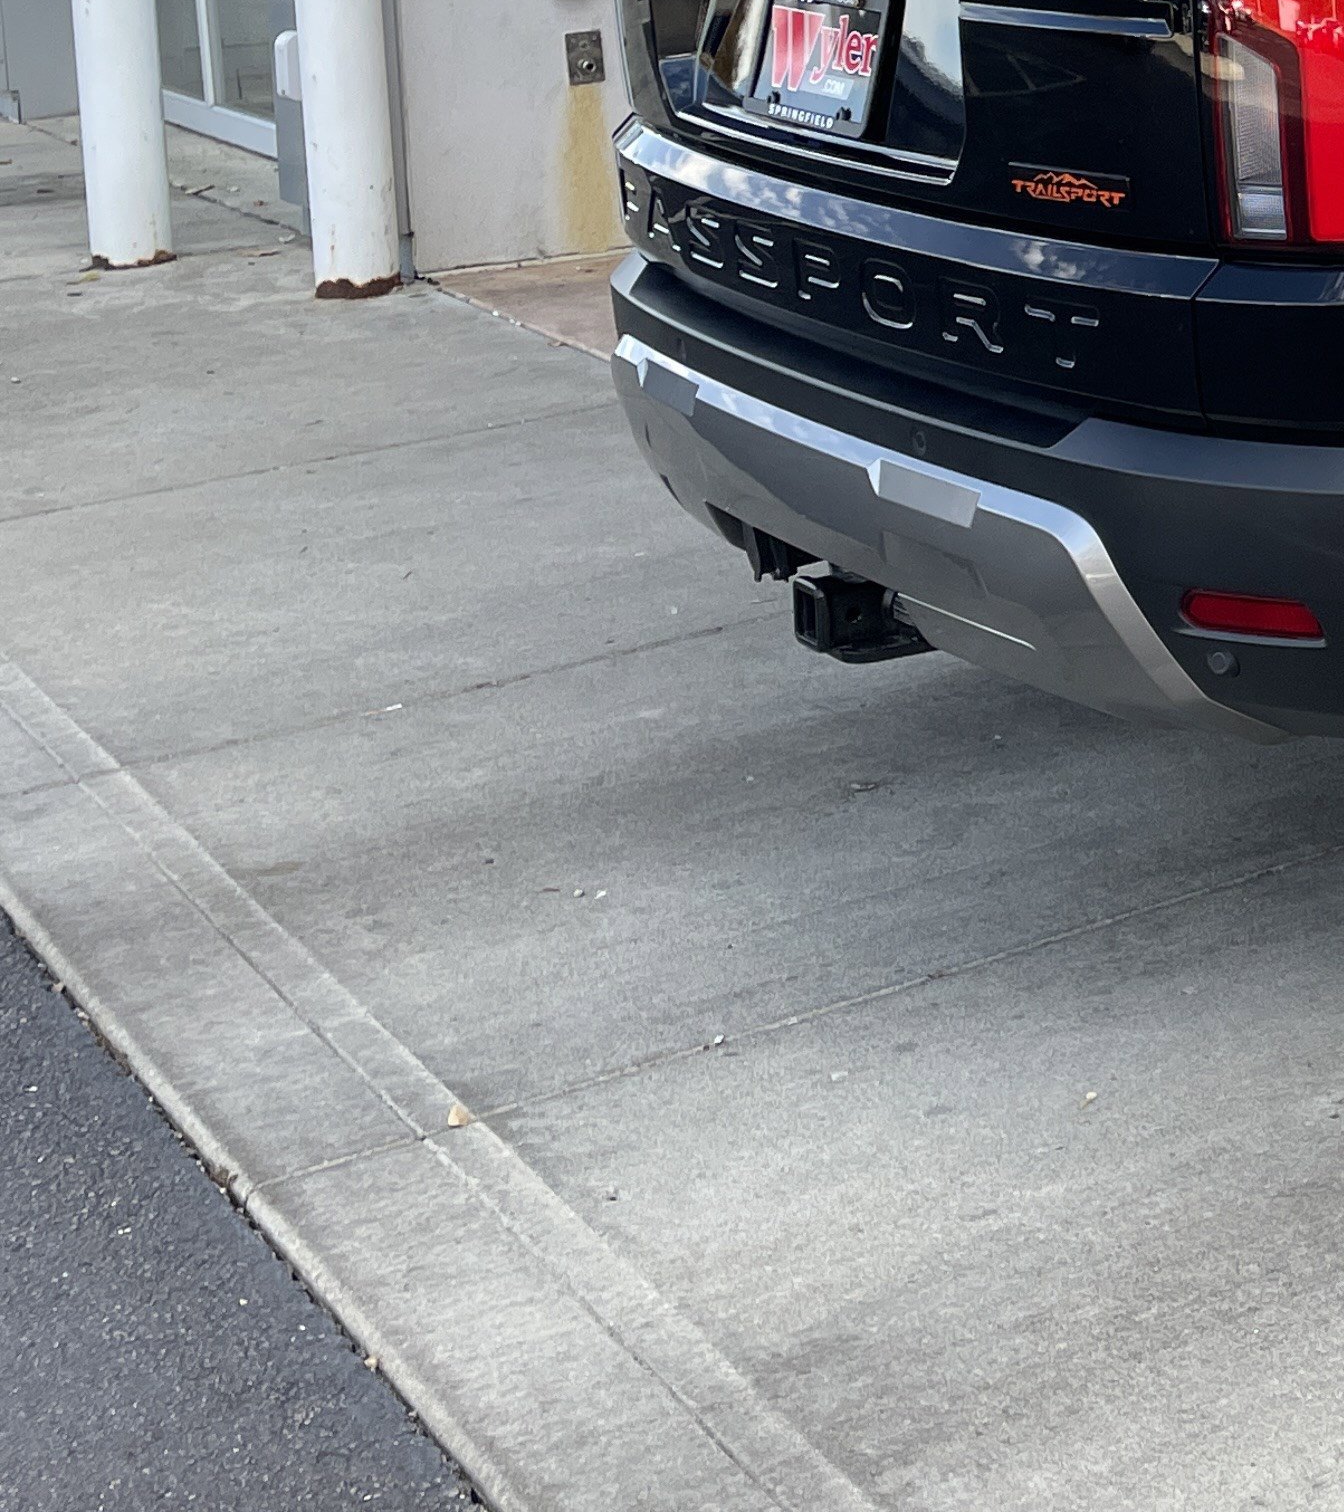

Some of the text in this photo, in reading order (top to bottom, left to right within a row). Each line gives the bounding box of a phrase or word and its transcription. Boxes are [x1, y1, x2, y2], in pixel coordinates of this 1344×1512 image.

[771, 5, 879, 91] Wyler
[768, 103, 834, 129] SPRINGFIELD
[1011, 179, 1126, 208] TRAILSPORT
[619, 168, 1098, 370] PASSPORT
